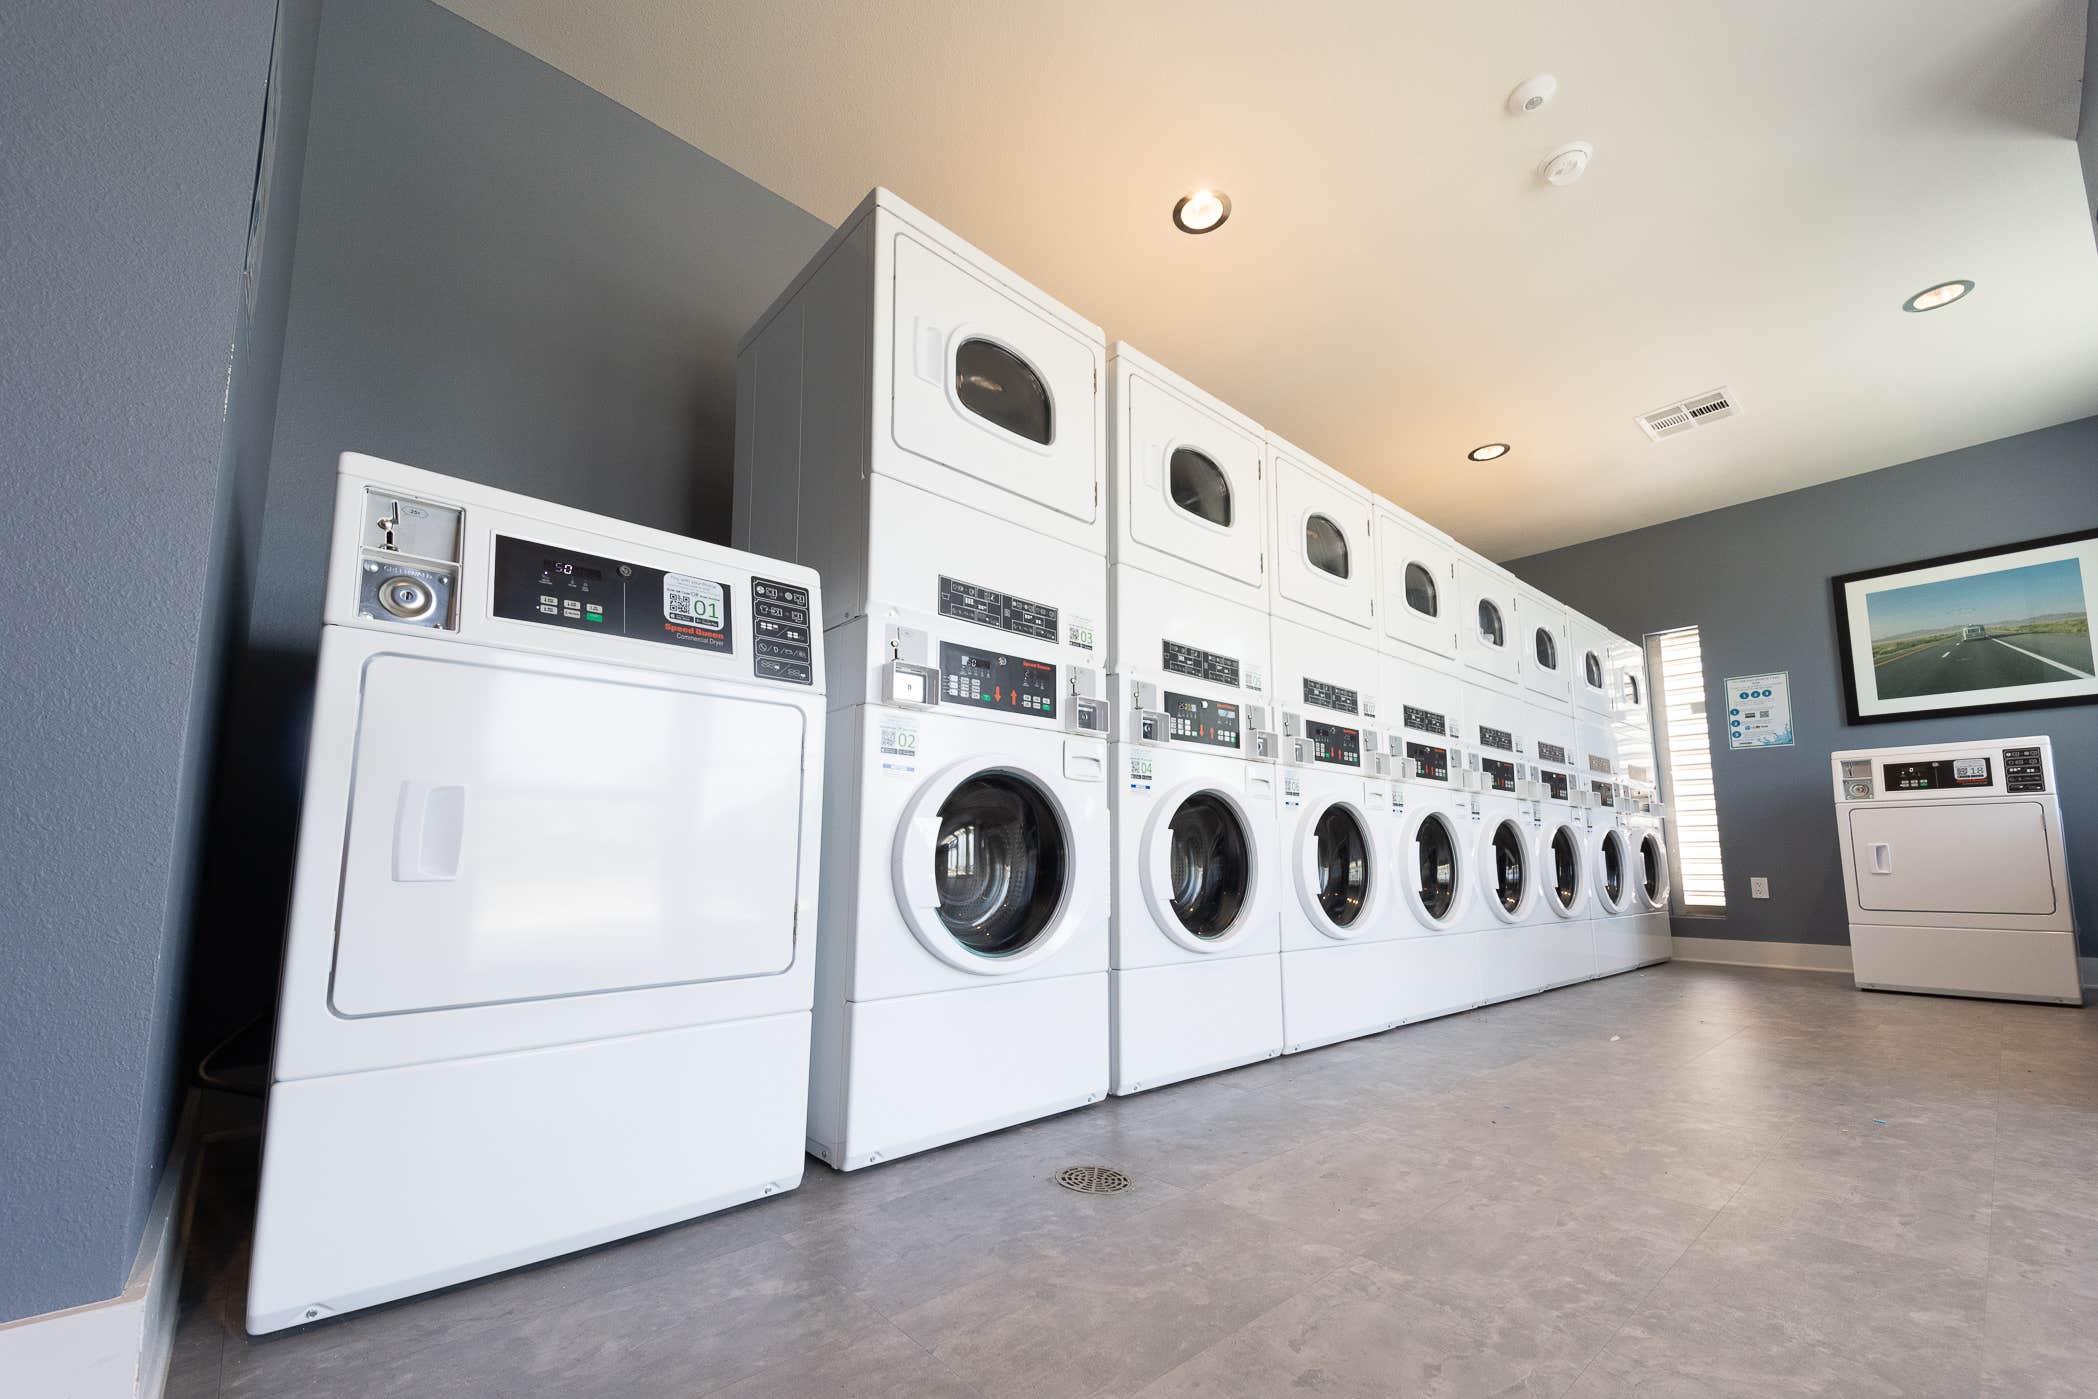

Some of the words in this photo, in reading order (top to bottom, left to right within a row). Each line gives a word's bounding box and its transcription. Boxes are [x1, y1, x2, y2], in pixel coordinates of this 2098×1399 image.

[694, 600, 719, 618] 01
[665, 623, 695, 633] Speed
[695, 628, 724, 639] Queen
[676, 633, 709, 643] Commercial
[1080, 630, 1093, 644] 03
[898, 732, 916, 749] 02
[1140, 762, 1153, 774] 04
